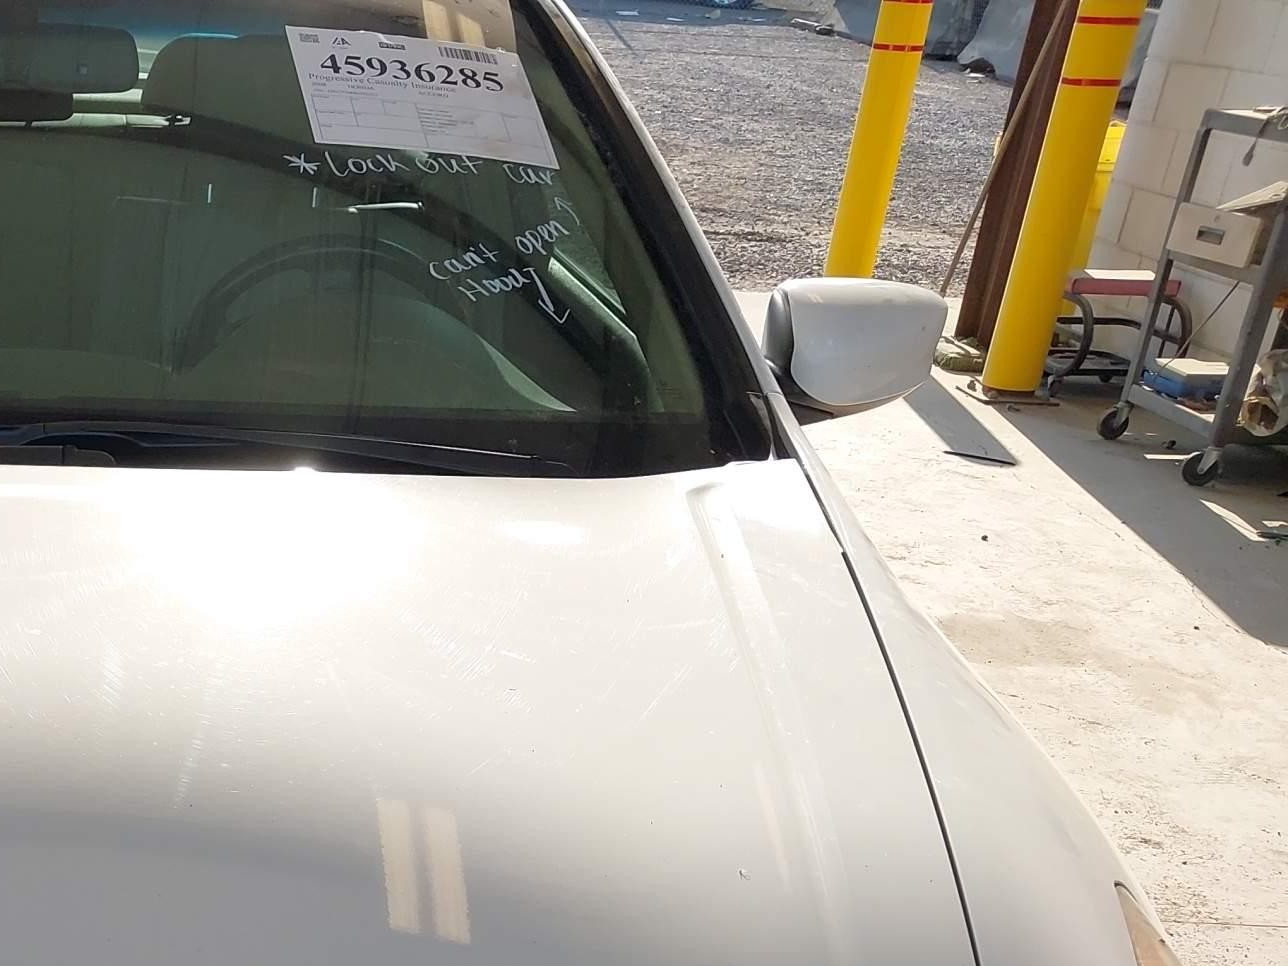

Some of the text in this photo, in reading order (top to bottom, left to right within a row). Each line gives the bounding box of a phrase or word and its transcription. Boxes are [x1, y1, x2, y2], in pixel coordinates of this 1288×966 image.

[309, 73, 365, 84] Progressive
[367, 78, 408, 88] Casualty
[411, 82, 456, 93] Insurance
[320, 54, 504, 92] 45936285
[515, 220, 570, 255] open
[457, 267, 531, 302] Hood
